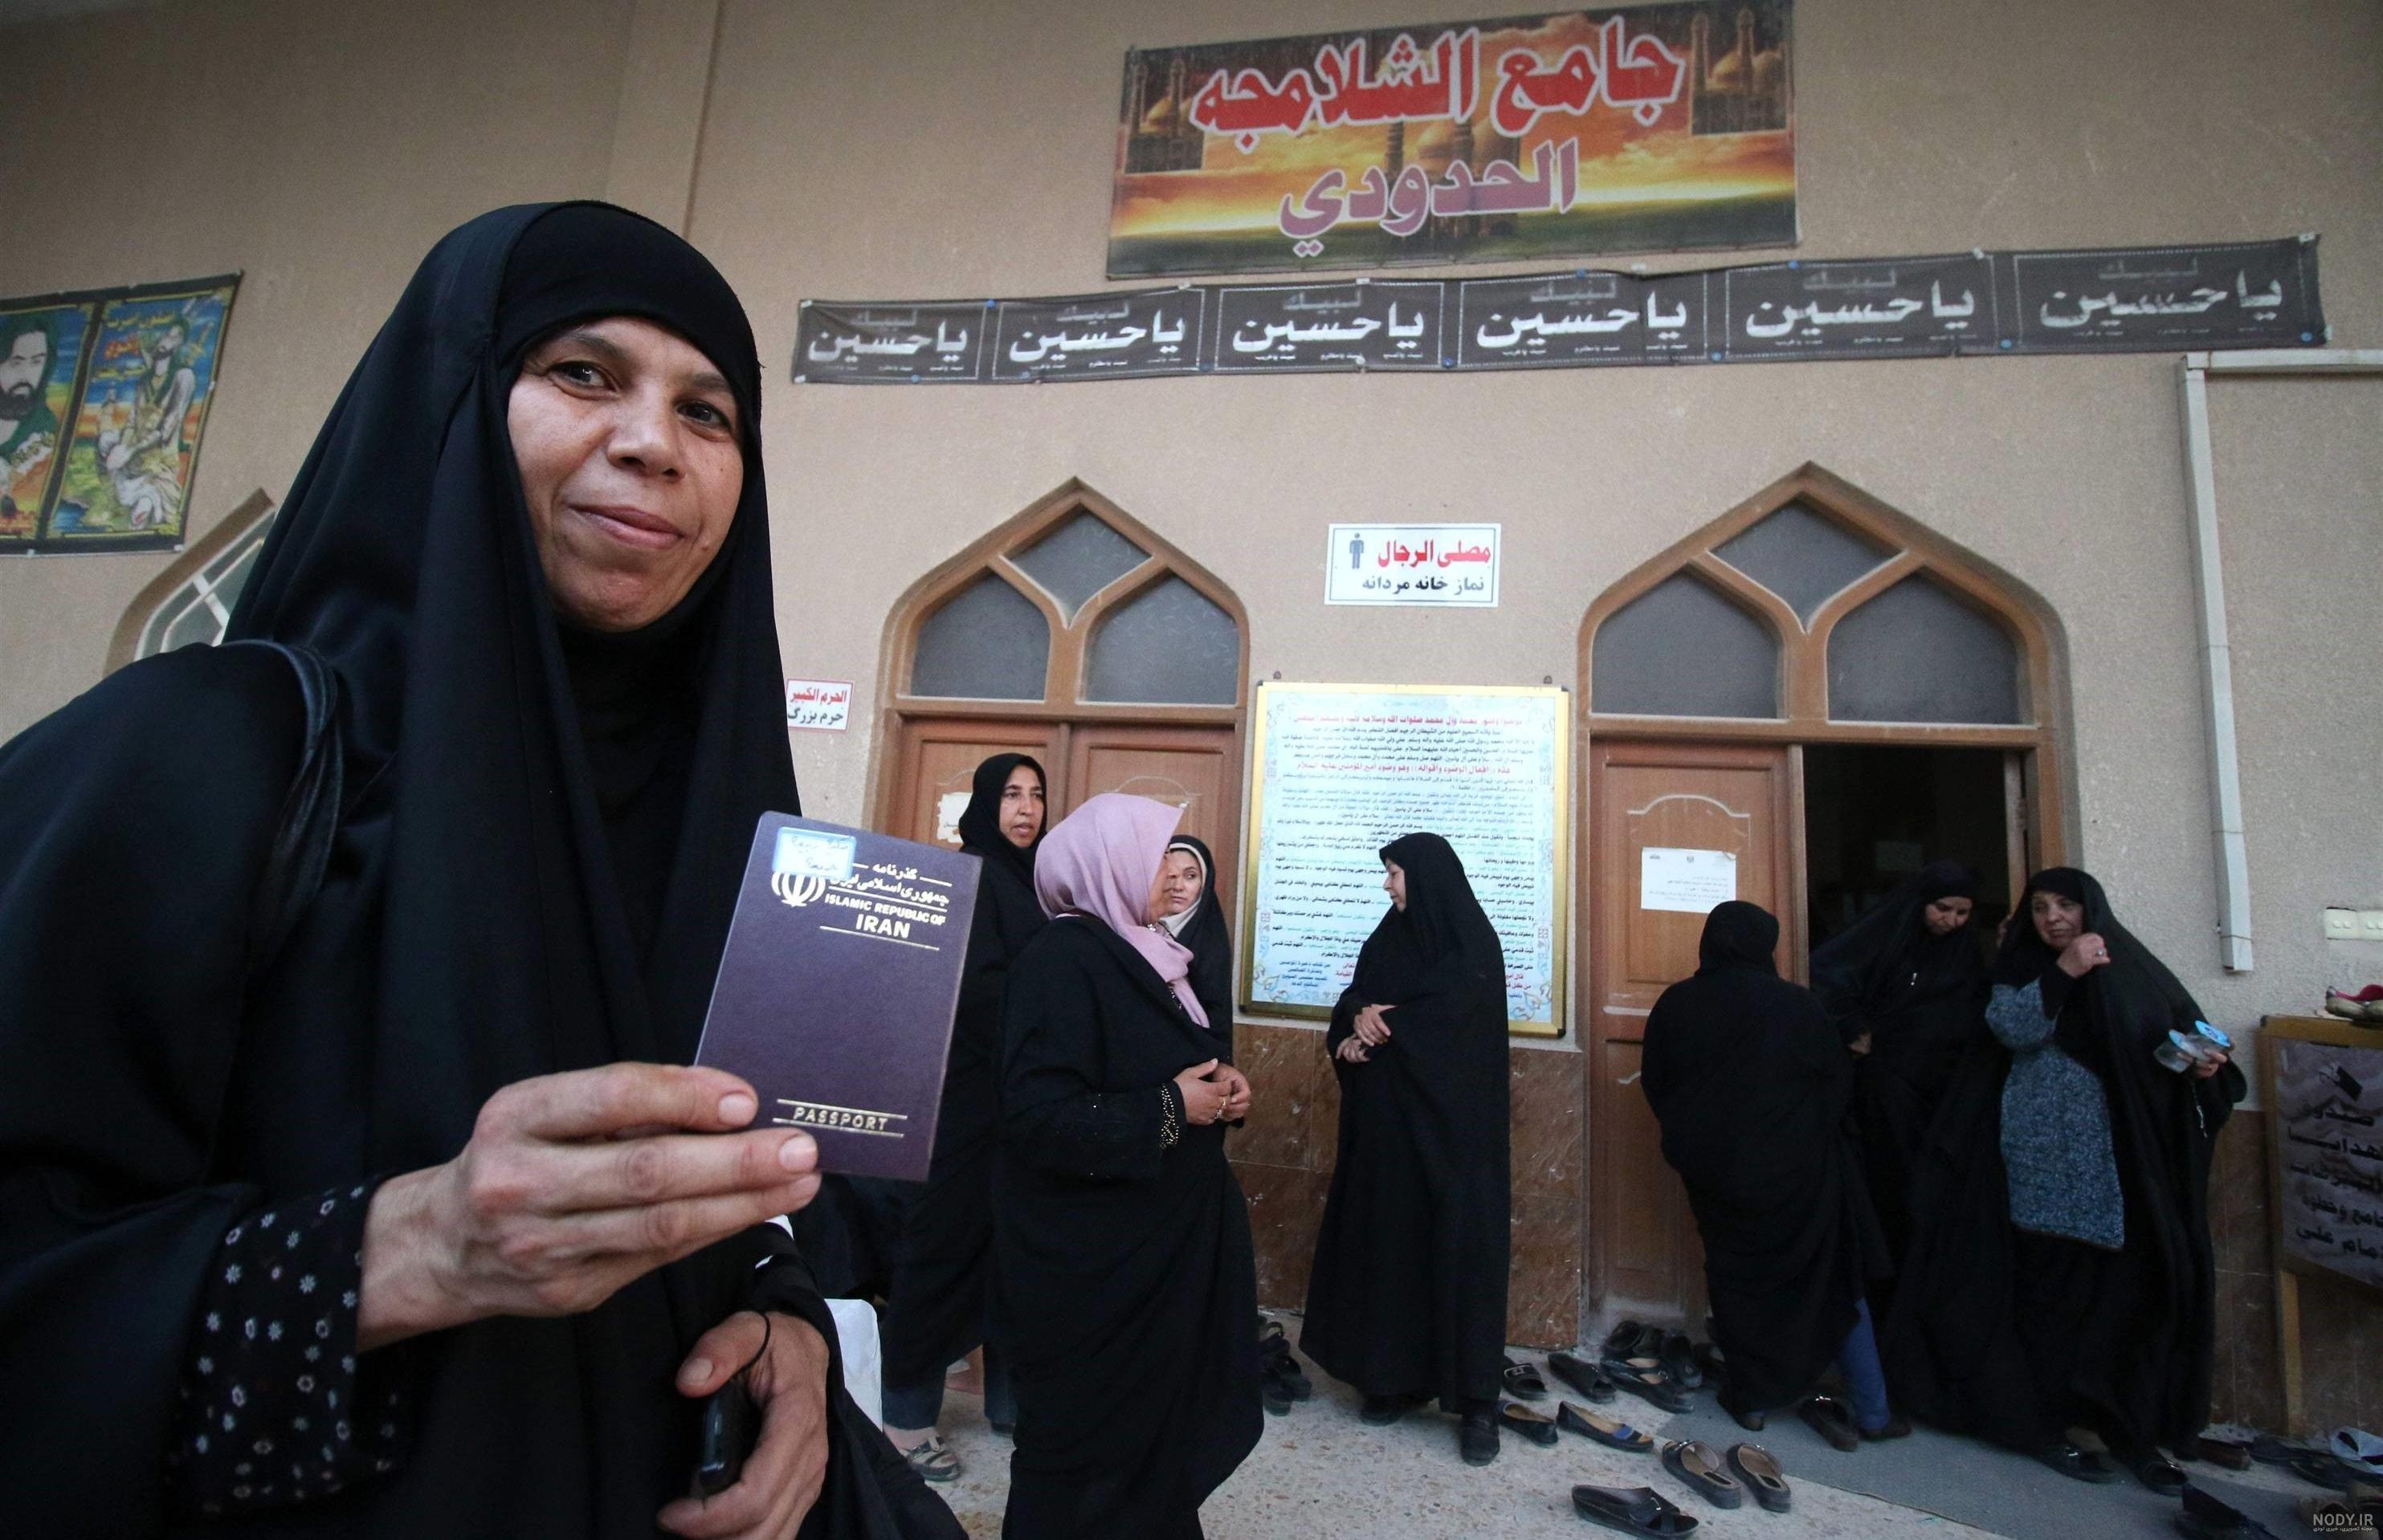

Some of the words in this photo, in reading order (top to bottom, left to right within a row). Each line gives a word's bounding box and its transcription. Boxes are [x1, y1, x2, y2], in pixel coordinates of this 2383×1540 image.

[1491, 14, 1687, 137] جامع
[1190, 26, 1481, 154] الشلامجه
[1279, 138, 1580, 259] الحدودي
[1377, 539, 1434, 568] الرجال
[1362, 576, 1410, 594] مردانه
[1415, 576, 1448, 590] خانه
[1455, 576, 1484, 595] نماز
[872, 863, 918, 880] گذرنامه
[824, 893, 872, 911] ISLAMIC
[874, 902, 930, 923] REPUBLIC
[930, 914, 947, 925] OF
[855, 914, 911, 939] IRAN
[793, 1106, 889, 1131] PASSPORT
